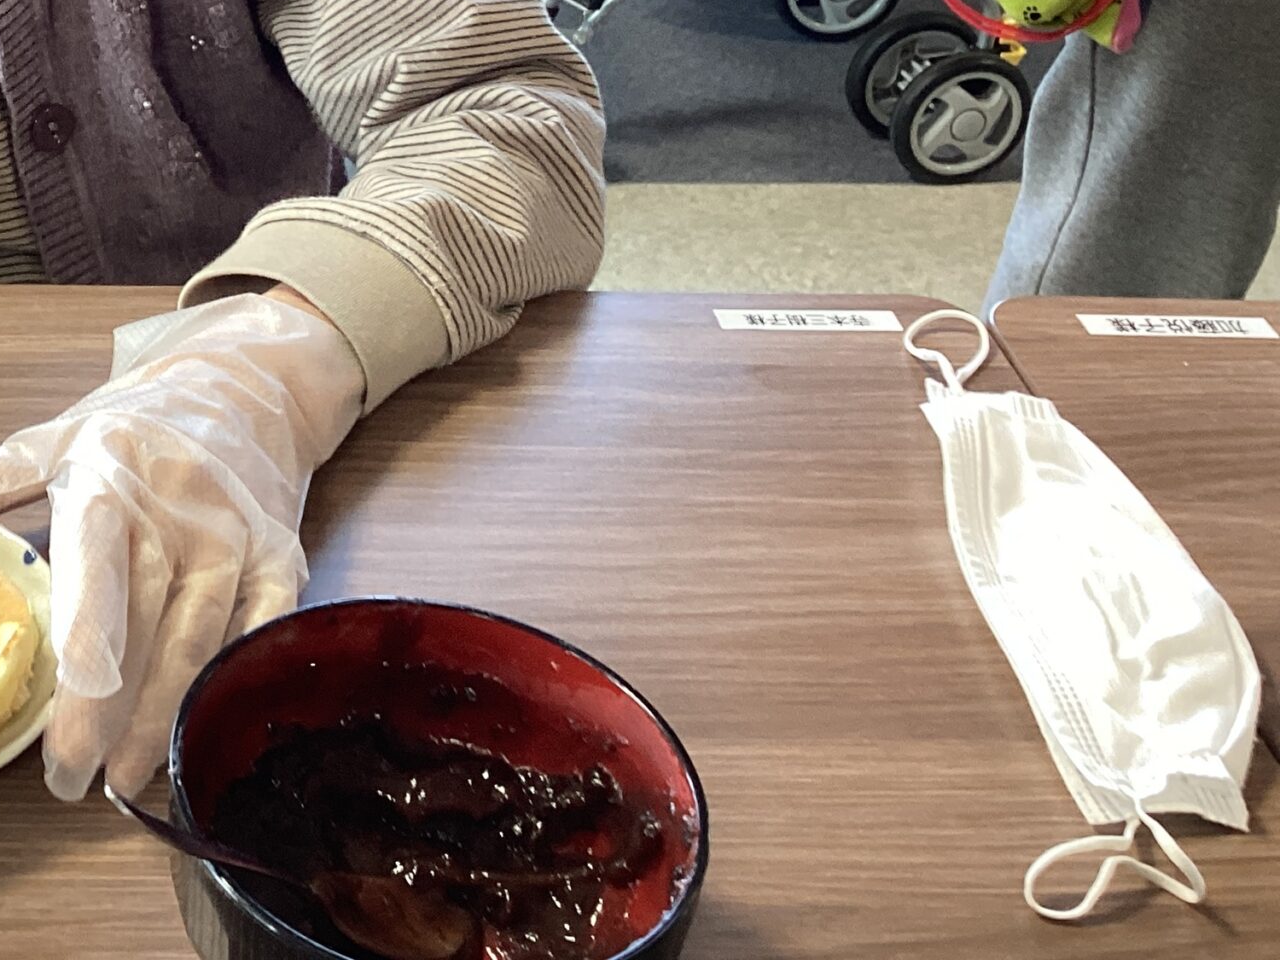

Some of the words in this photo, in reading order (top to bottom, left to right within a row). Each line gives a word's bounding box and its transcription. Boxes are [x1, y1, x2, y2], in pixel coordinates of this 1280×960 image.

[1106, 318, 1249, 334] 加藤悦子様
